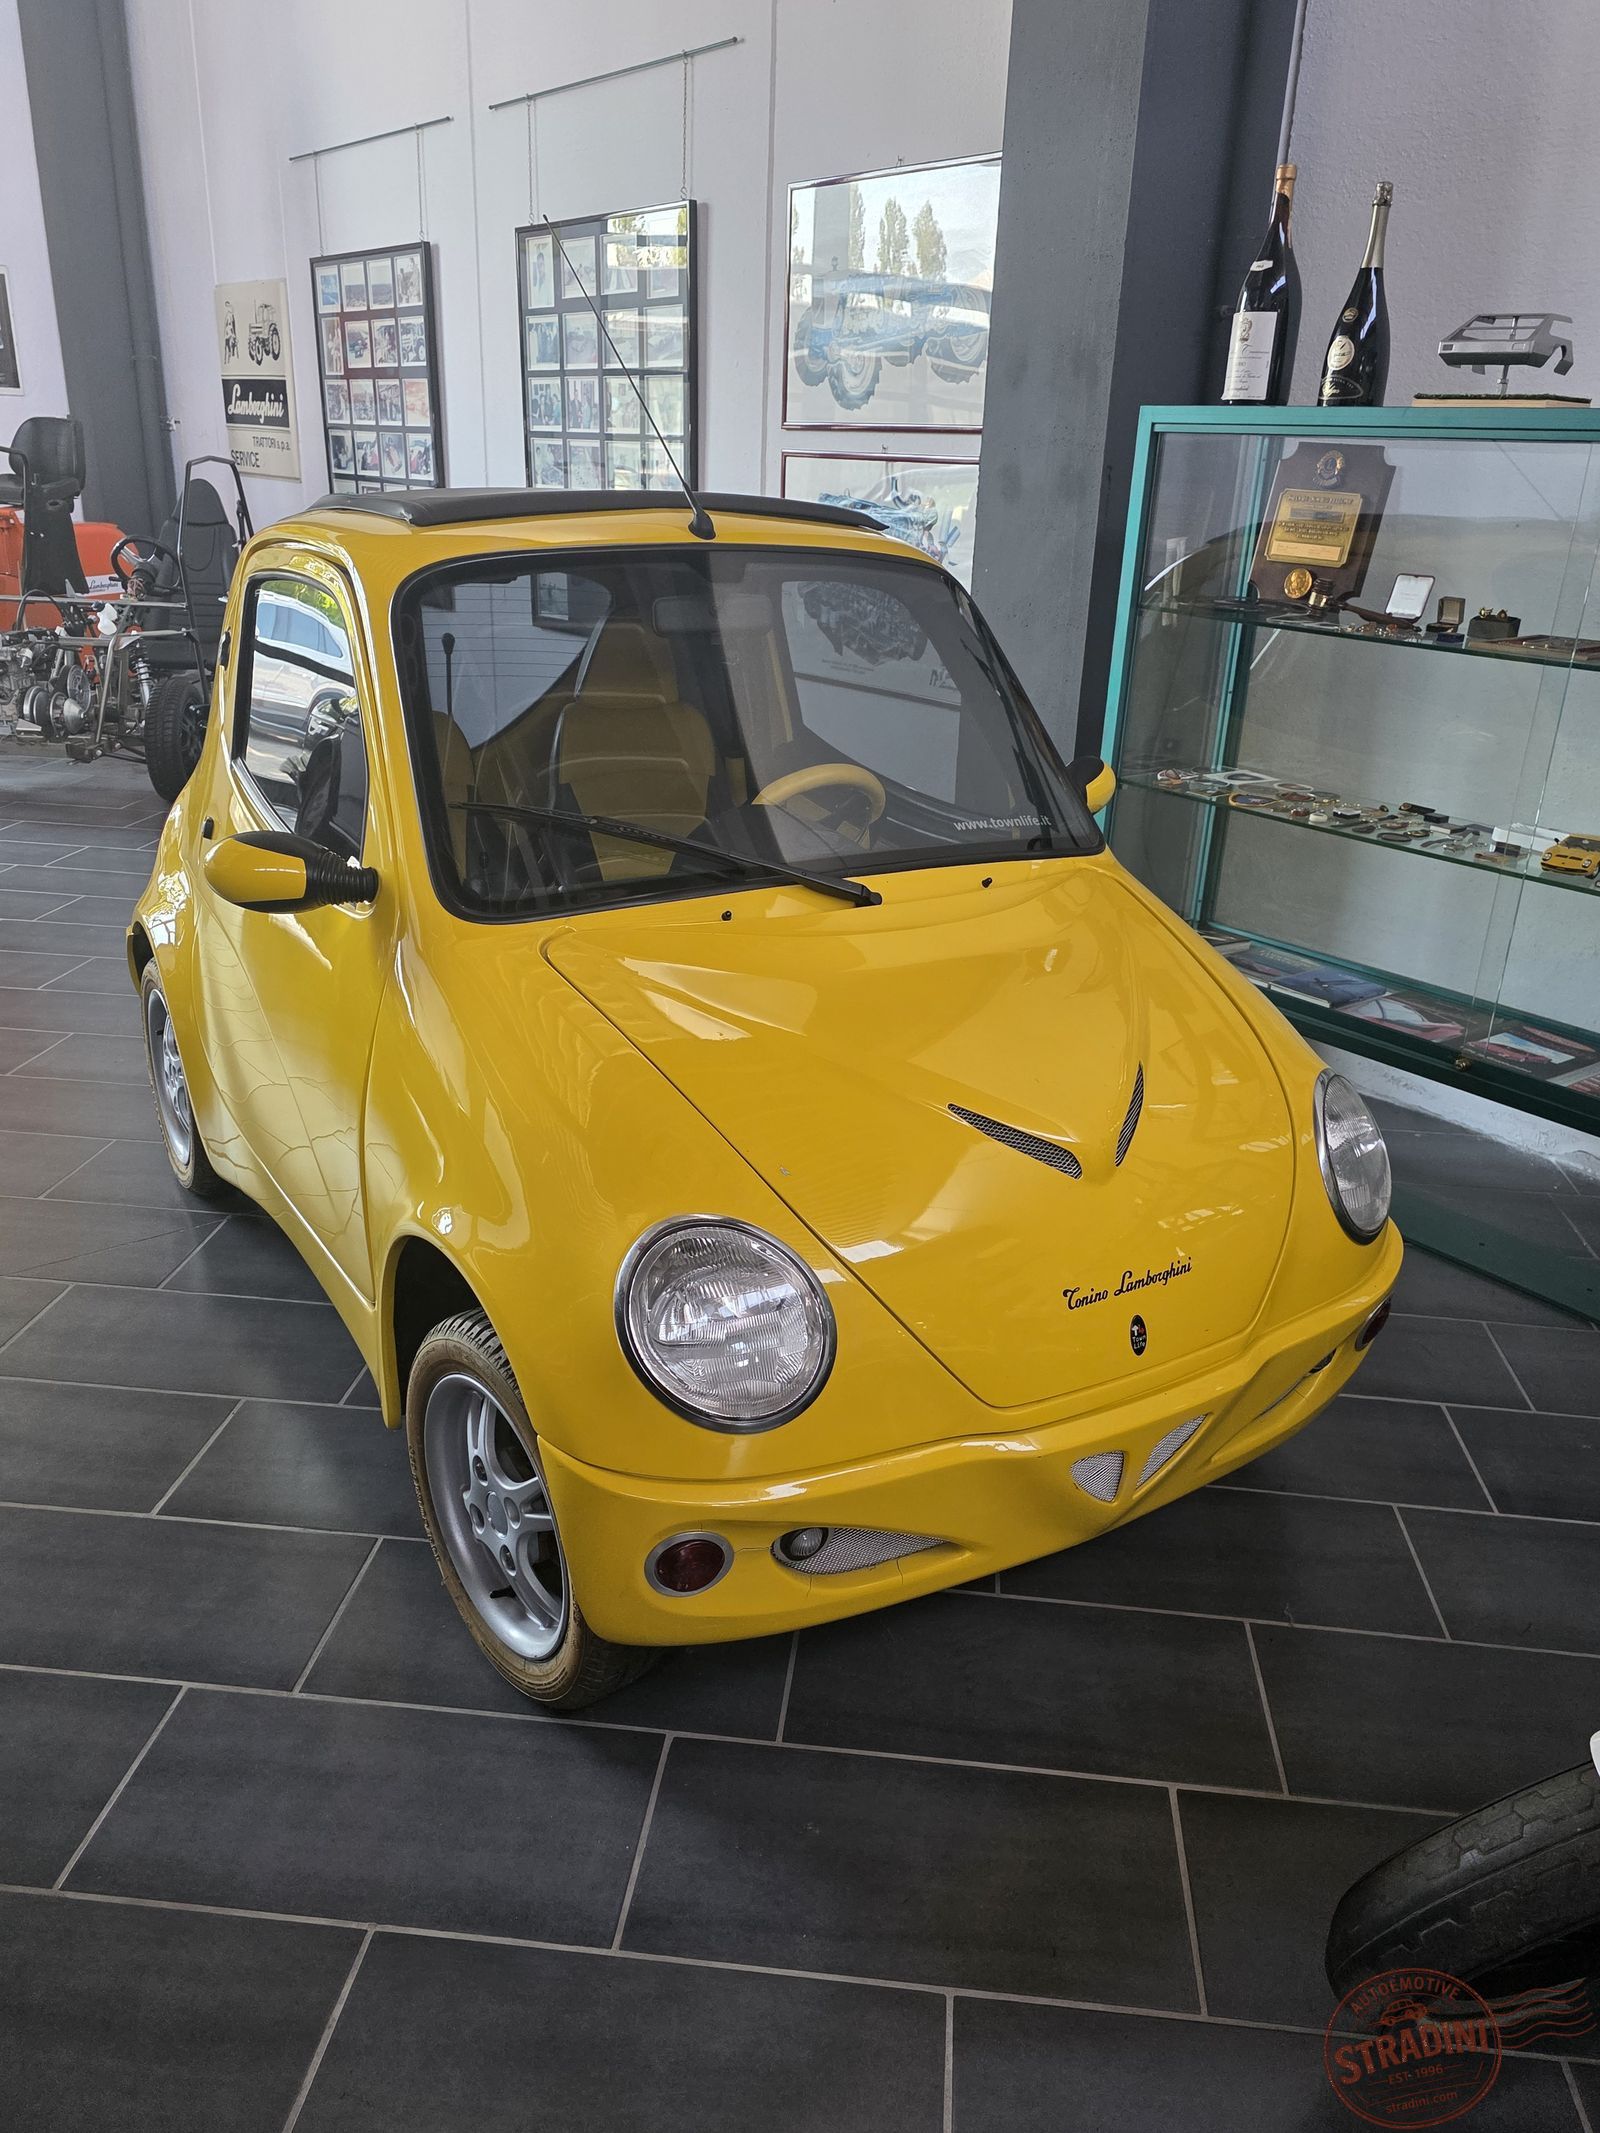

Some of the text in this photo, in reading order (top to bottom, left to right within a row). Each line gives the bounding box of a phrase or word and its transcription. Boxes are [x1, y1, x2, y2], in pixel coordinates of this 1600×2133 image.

[228, 384, 285, 424] Lamborghini
[252, 436, 276, 450] TRATTORI
[231, 449, 260, 468] SERVICE
[953, 815, 1052, 831] www.townlife.it
[1063, 1256, 1192, 1310] Tonino Lamborghini
